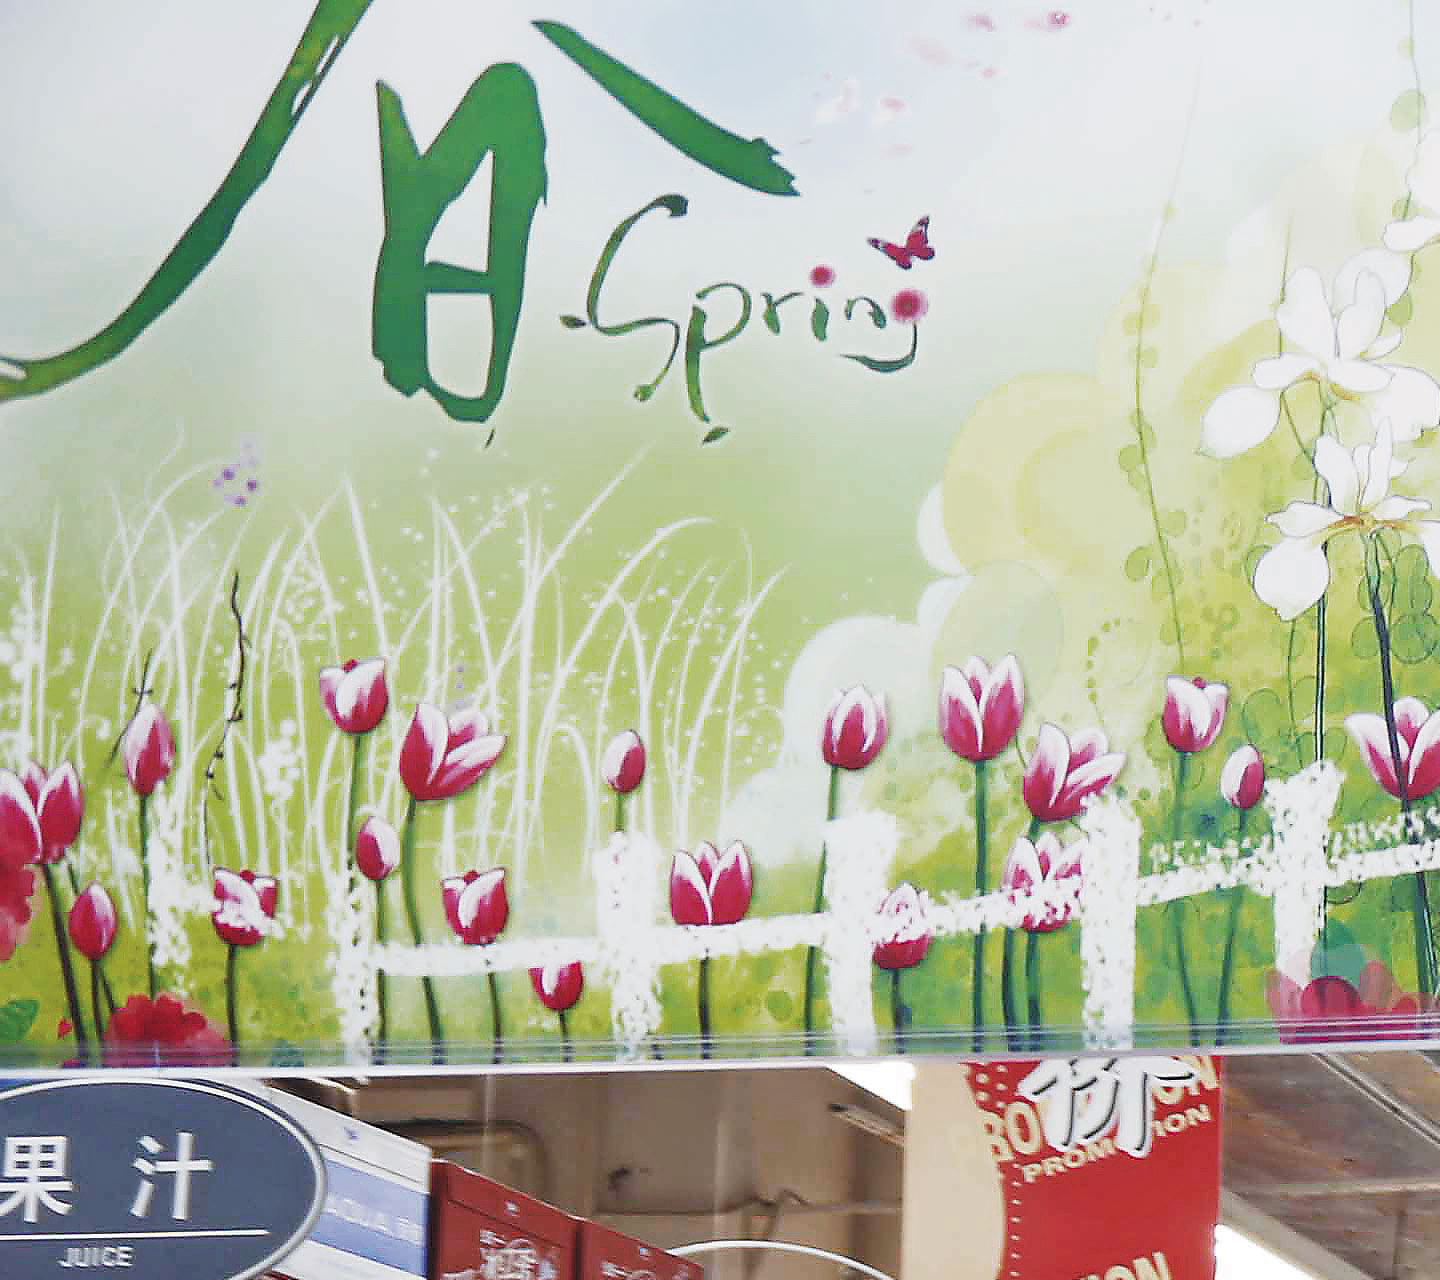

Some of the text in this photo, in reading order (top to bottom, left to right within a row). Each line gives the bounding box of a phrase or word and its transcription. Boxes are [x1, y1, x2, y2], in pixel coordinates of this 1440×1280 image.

[560, 193, 930, 440] Spring
[0, 1131, 214, 1223] 果汁
[58, 1245, 135, 1268] JUICE
